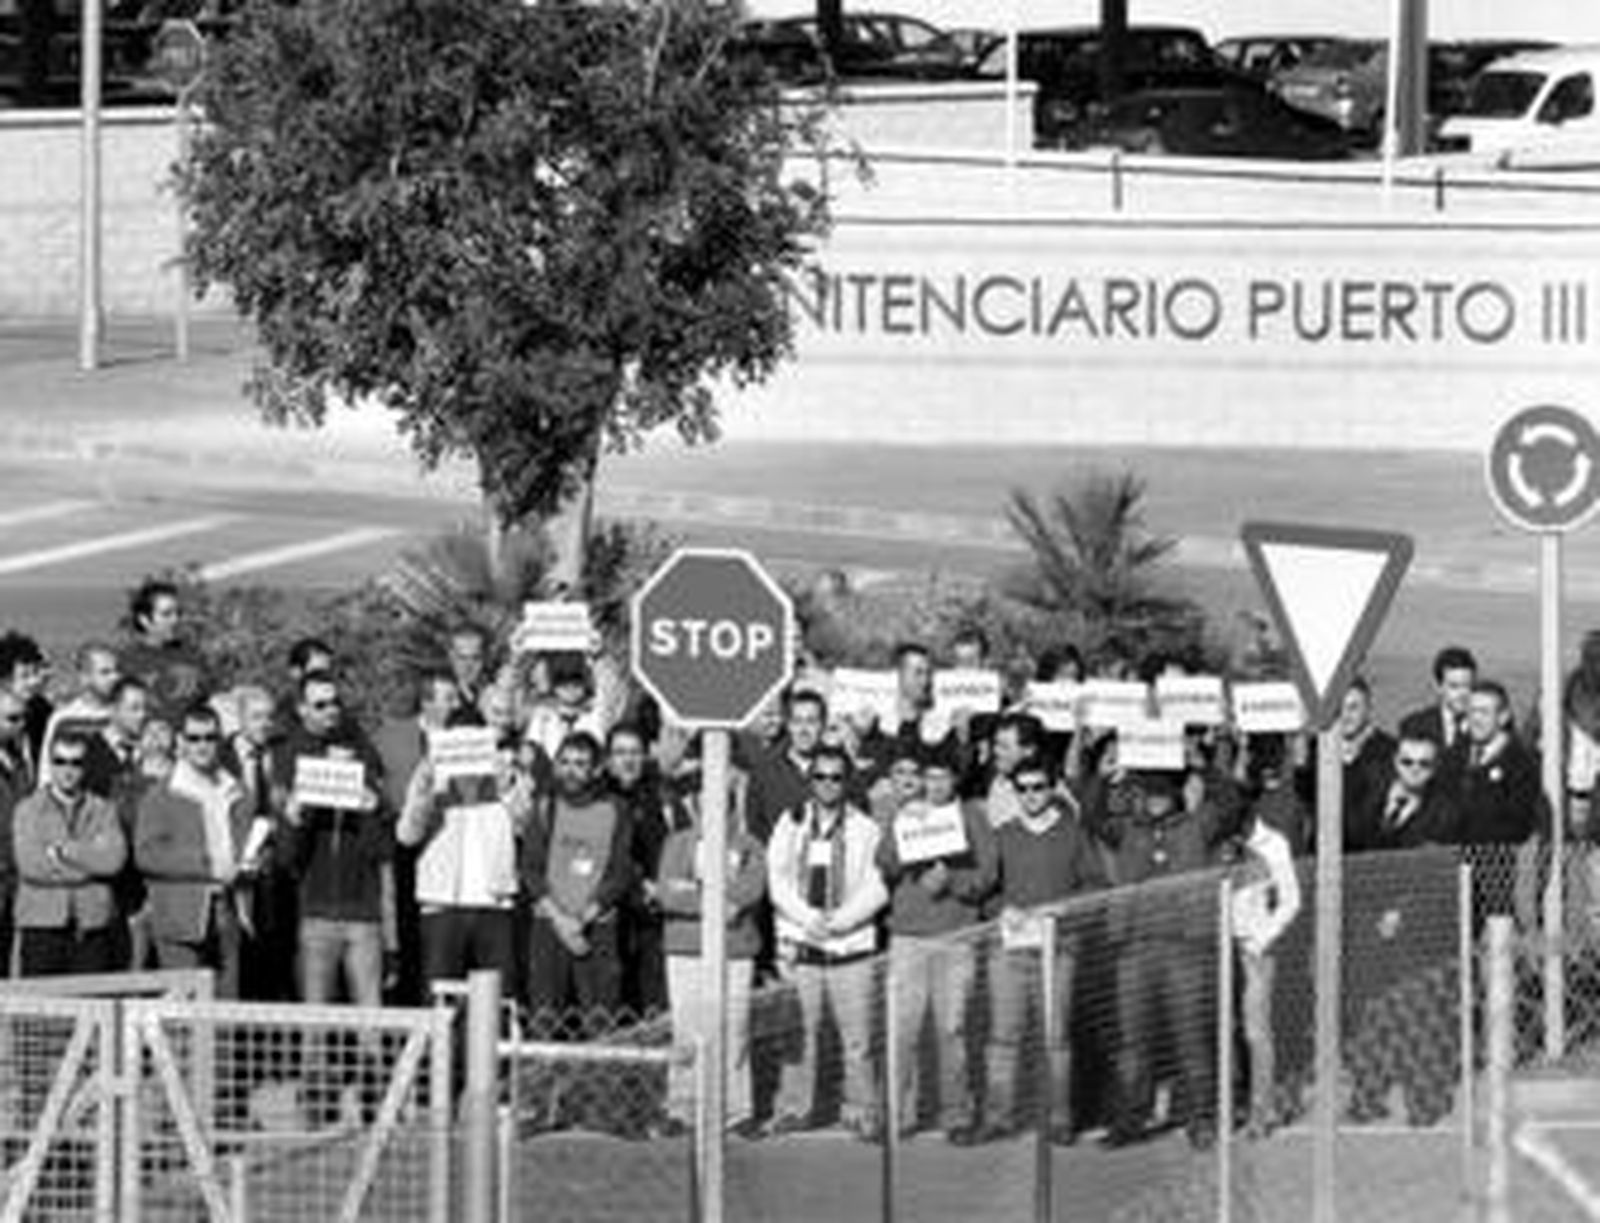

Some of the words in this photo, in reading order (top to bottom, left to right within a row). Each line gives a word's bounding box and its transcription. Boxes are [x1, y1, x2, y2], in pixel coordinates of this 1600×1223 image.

[783, 274, 1222, 341] NITENCIARIO
[1248, 279, 1516, 344] PUERTO
[1541, 281, 1587, 344] III
[650, 618, 774, 662] STOP
